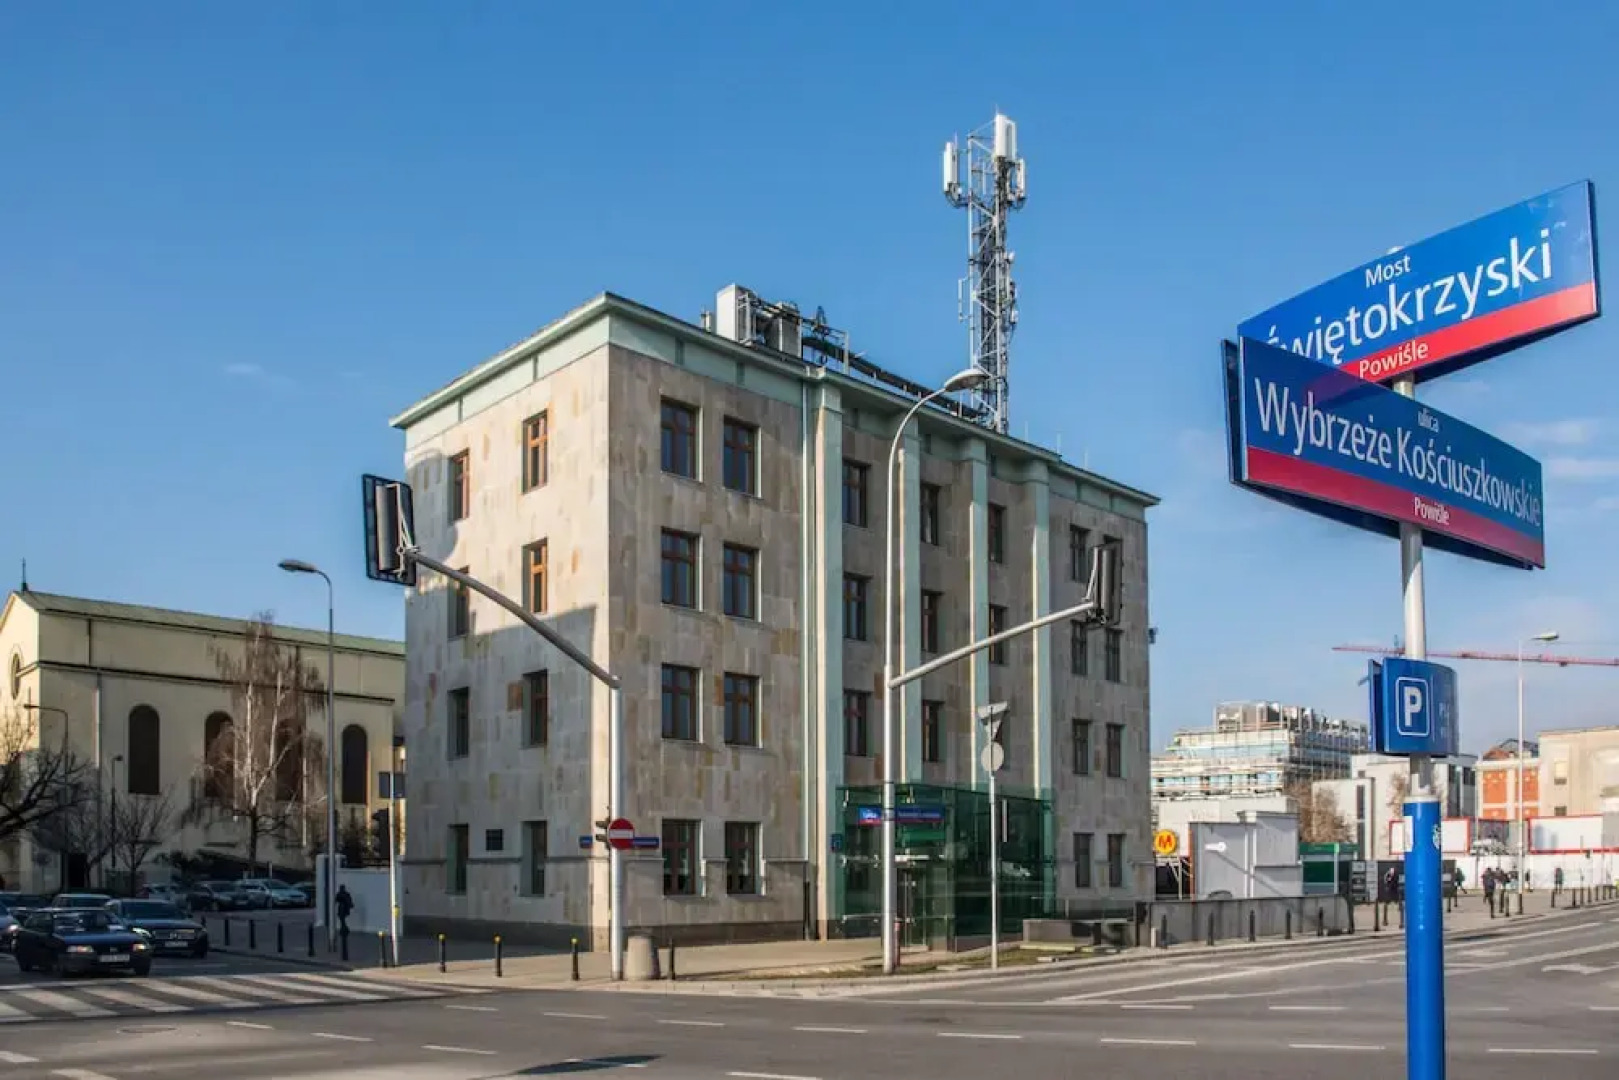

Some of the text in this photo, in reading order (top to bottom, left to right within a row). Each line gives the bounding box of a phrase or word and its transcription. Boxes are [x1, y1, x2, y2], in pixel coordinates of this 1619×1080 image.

[1366, 254, 1411, 288] Most
[1359, 339, 1429, 379] Powiśle
[1417, 407, 1439, 433] ulica
[1254, 377, 1541, 527] Wybrzeże Kościuszkowskie
[1414, 496, 1450, 525] Powiśle
[1403, 686, 1422, 727] P
[1158, 834, 1173, 848] M
